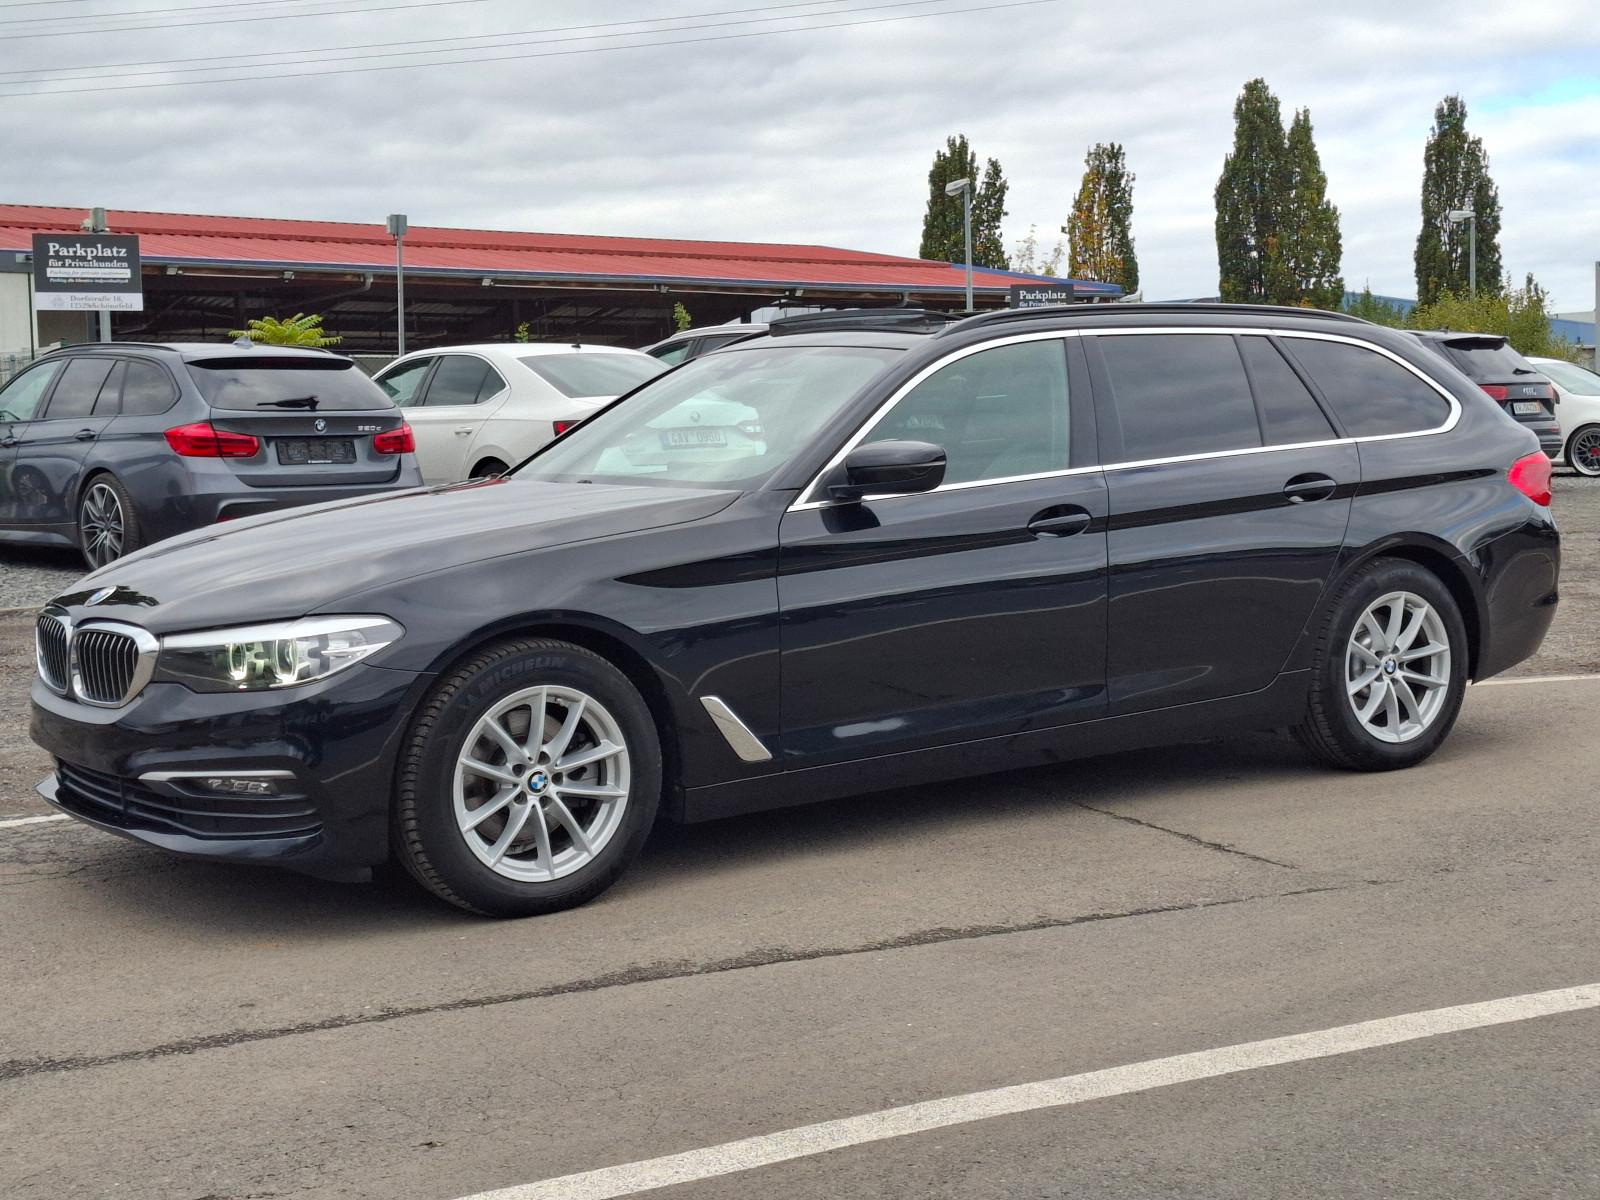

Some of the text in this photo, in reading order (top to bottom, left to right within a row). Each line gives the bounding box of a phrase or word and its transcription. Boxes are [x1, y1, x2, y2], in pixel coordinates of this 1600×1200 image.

[47, 242, 127, 260] Parkplatz
[48, 259, 129, 268] für Privatkunden
[1020, 290, 1067, 301] Parkplatz
[478, 656, 568, 695] MICHELIN
